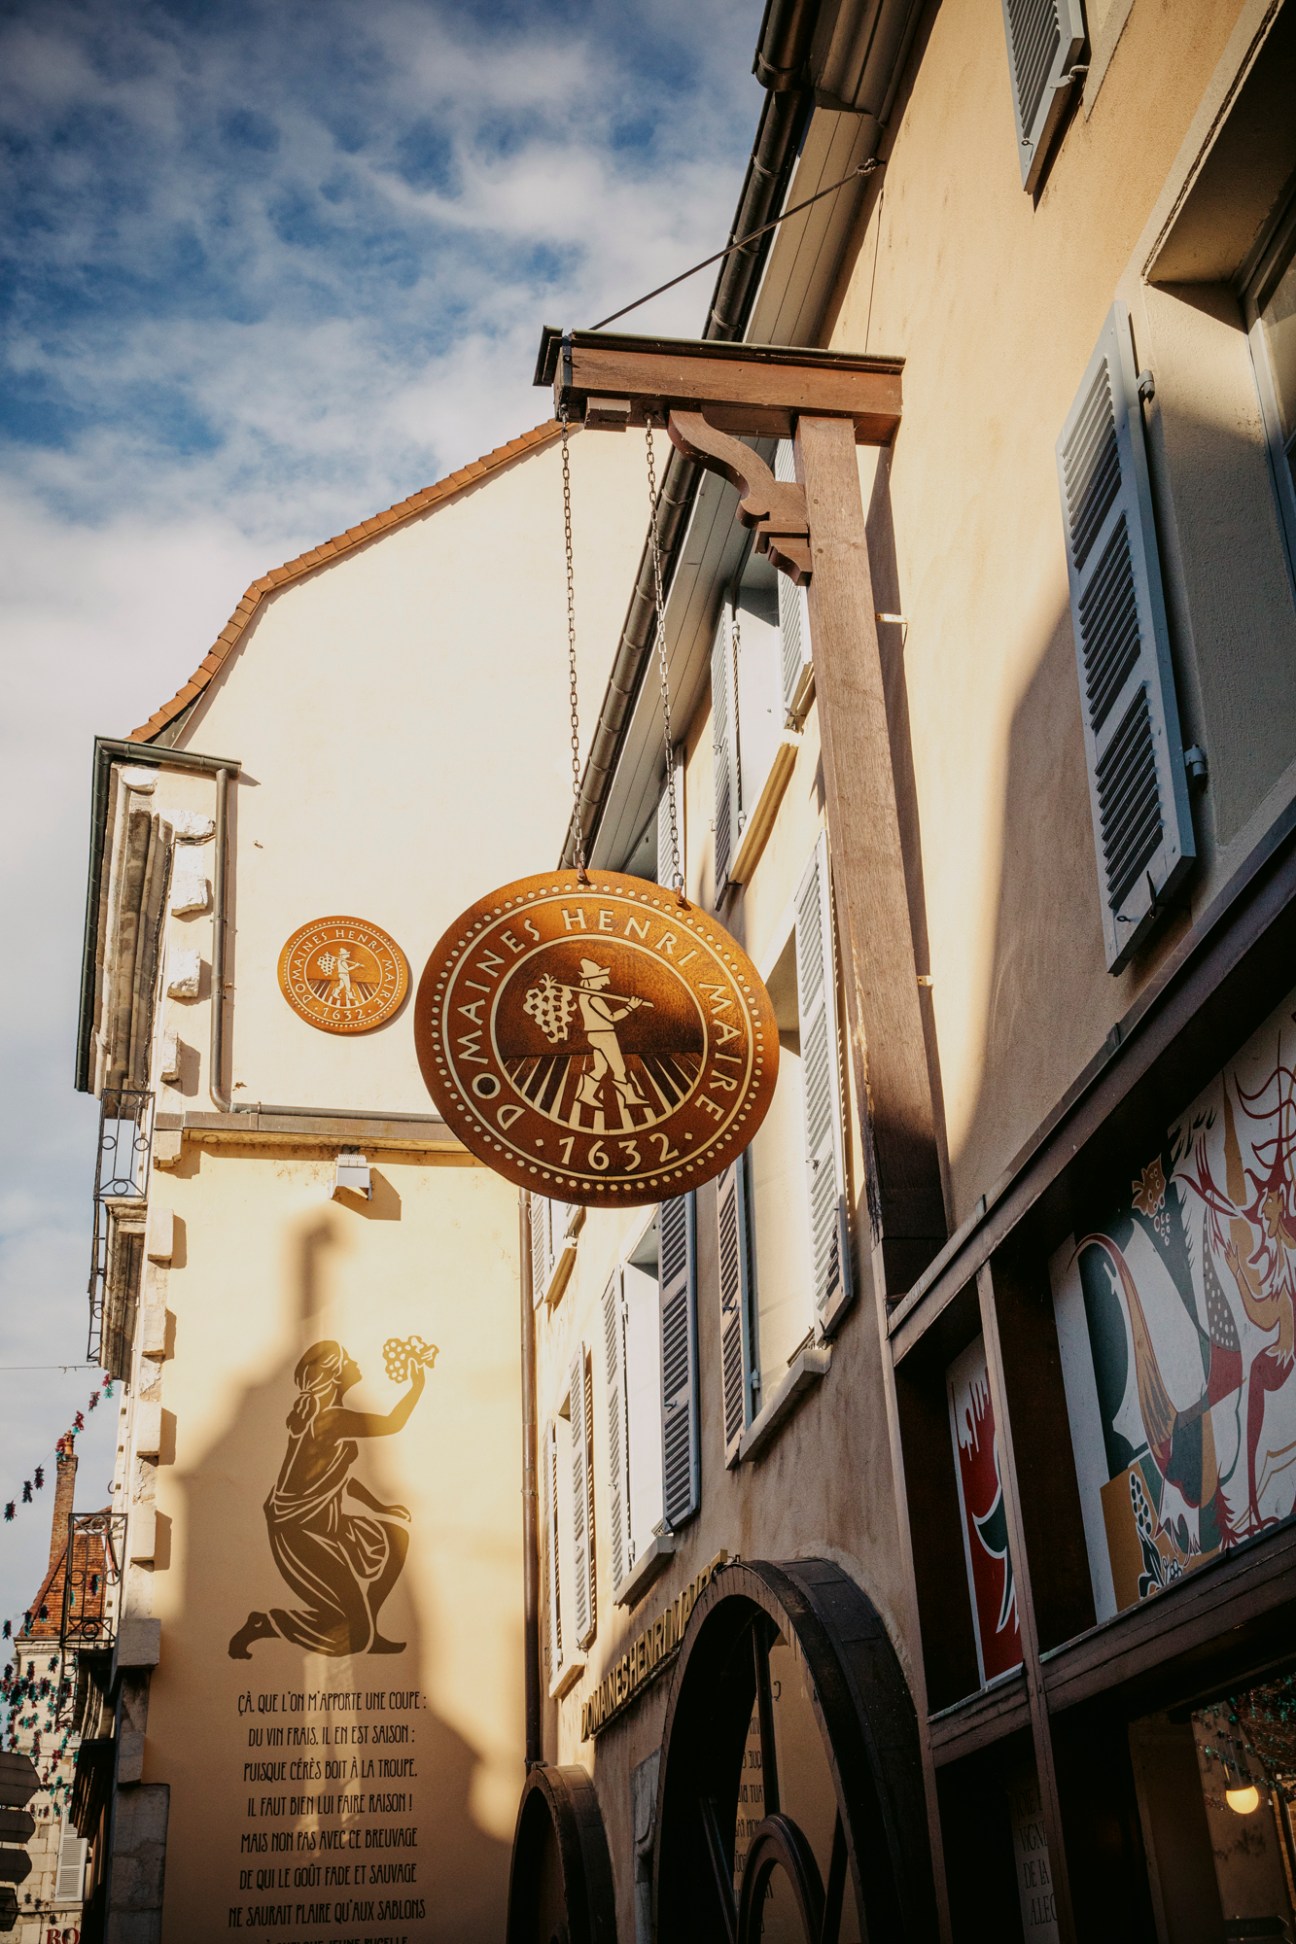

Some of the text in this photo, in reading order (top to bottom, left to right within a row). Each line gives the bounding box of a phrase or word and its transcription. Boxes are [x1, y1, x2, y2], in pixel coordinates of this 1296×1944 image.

[291, 929, 395, 1008] DOMAINES HENRI MAIRE
[322, 1007, 366, 1021] 1632
[456, 907, 742, 1131] DOMAINES HENRI MAIRE
[558, 1132, 680, 1172] 1632
[580, 1654, 630, 1743] DOMAINES
[628, 1608, 672, 1692] HENRI
[257, 1693, 279, 1714] QUE
[281, 1690, 305, 1712] L'ON
[307, 1690, 363, 1711] M'APPORTE
[365, 1691, 386, 1710] UNE
[248, 1727, 263, 1747] DU
[266, 1727, 284, 1746] VIN
[321, 1726, 331, 1745] IL
[334, 1725, 348, 1744] EN
[351, 1725, 369, 1744] EST
[243, 1761, 287, 1783] PUISQUE
[289, 1756, 322, 1780] CÉRÈS
[324, 1759, 347, 1779] BOIT
[350, 1756, 358, 1779] À
[361, 1759, 375, 1778] LA
[247, 1797, 257, 1817] IL
[259, 1796, 287, 1816] FAUT
[289, 1795, 314, 1815] BIEN
[317, 1795, 334, 1815] LUI
[336, 1793, 366, 1813] FAIRE
[240, 1827, 418, 1853] MAIS NON PAS AVEC CE BREUVAGE
[239, 1862, 417, 1891] DE QUI LE GOÛT FADE ET SAUVAGE
[228, 1898, 426, 1928] NE SAURAIT PLAIRE QU'AUX SABLONS
